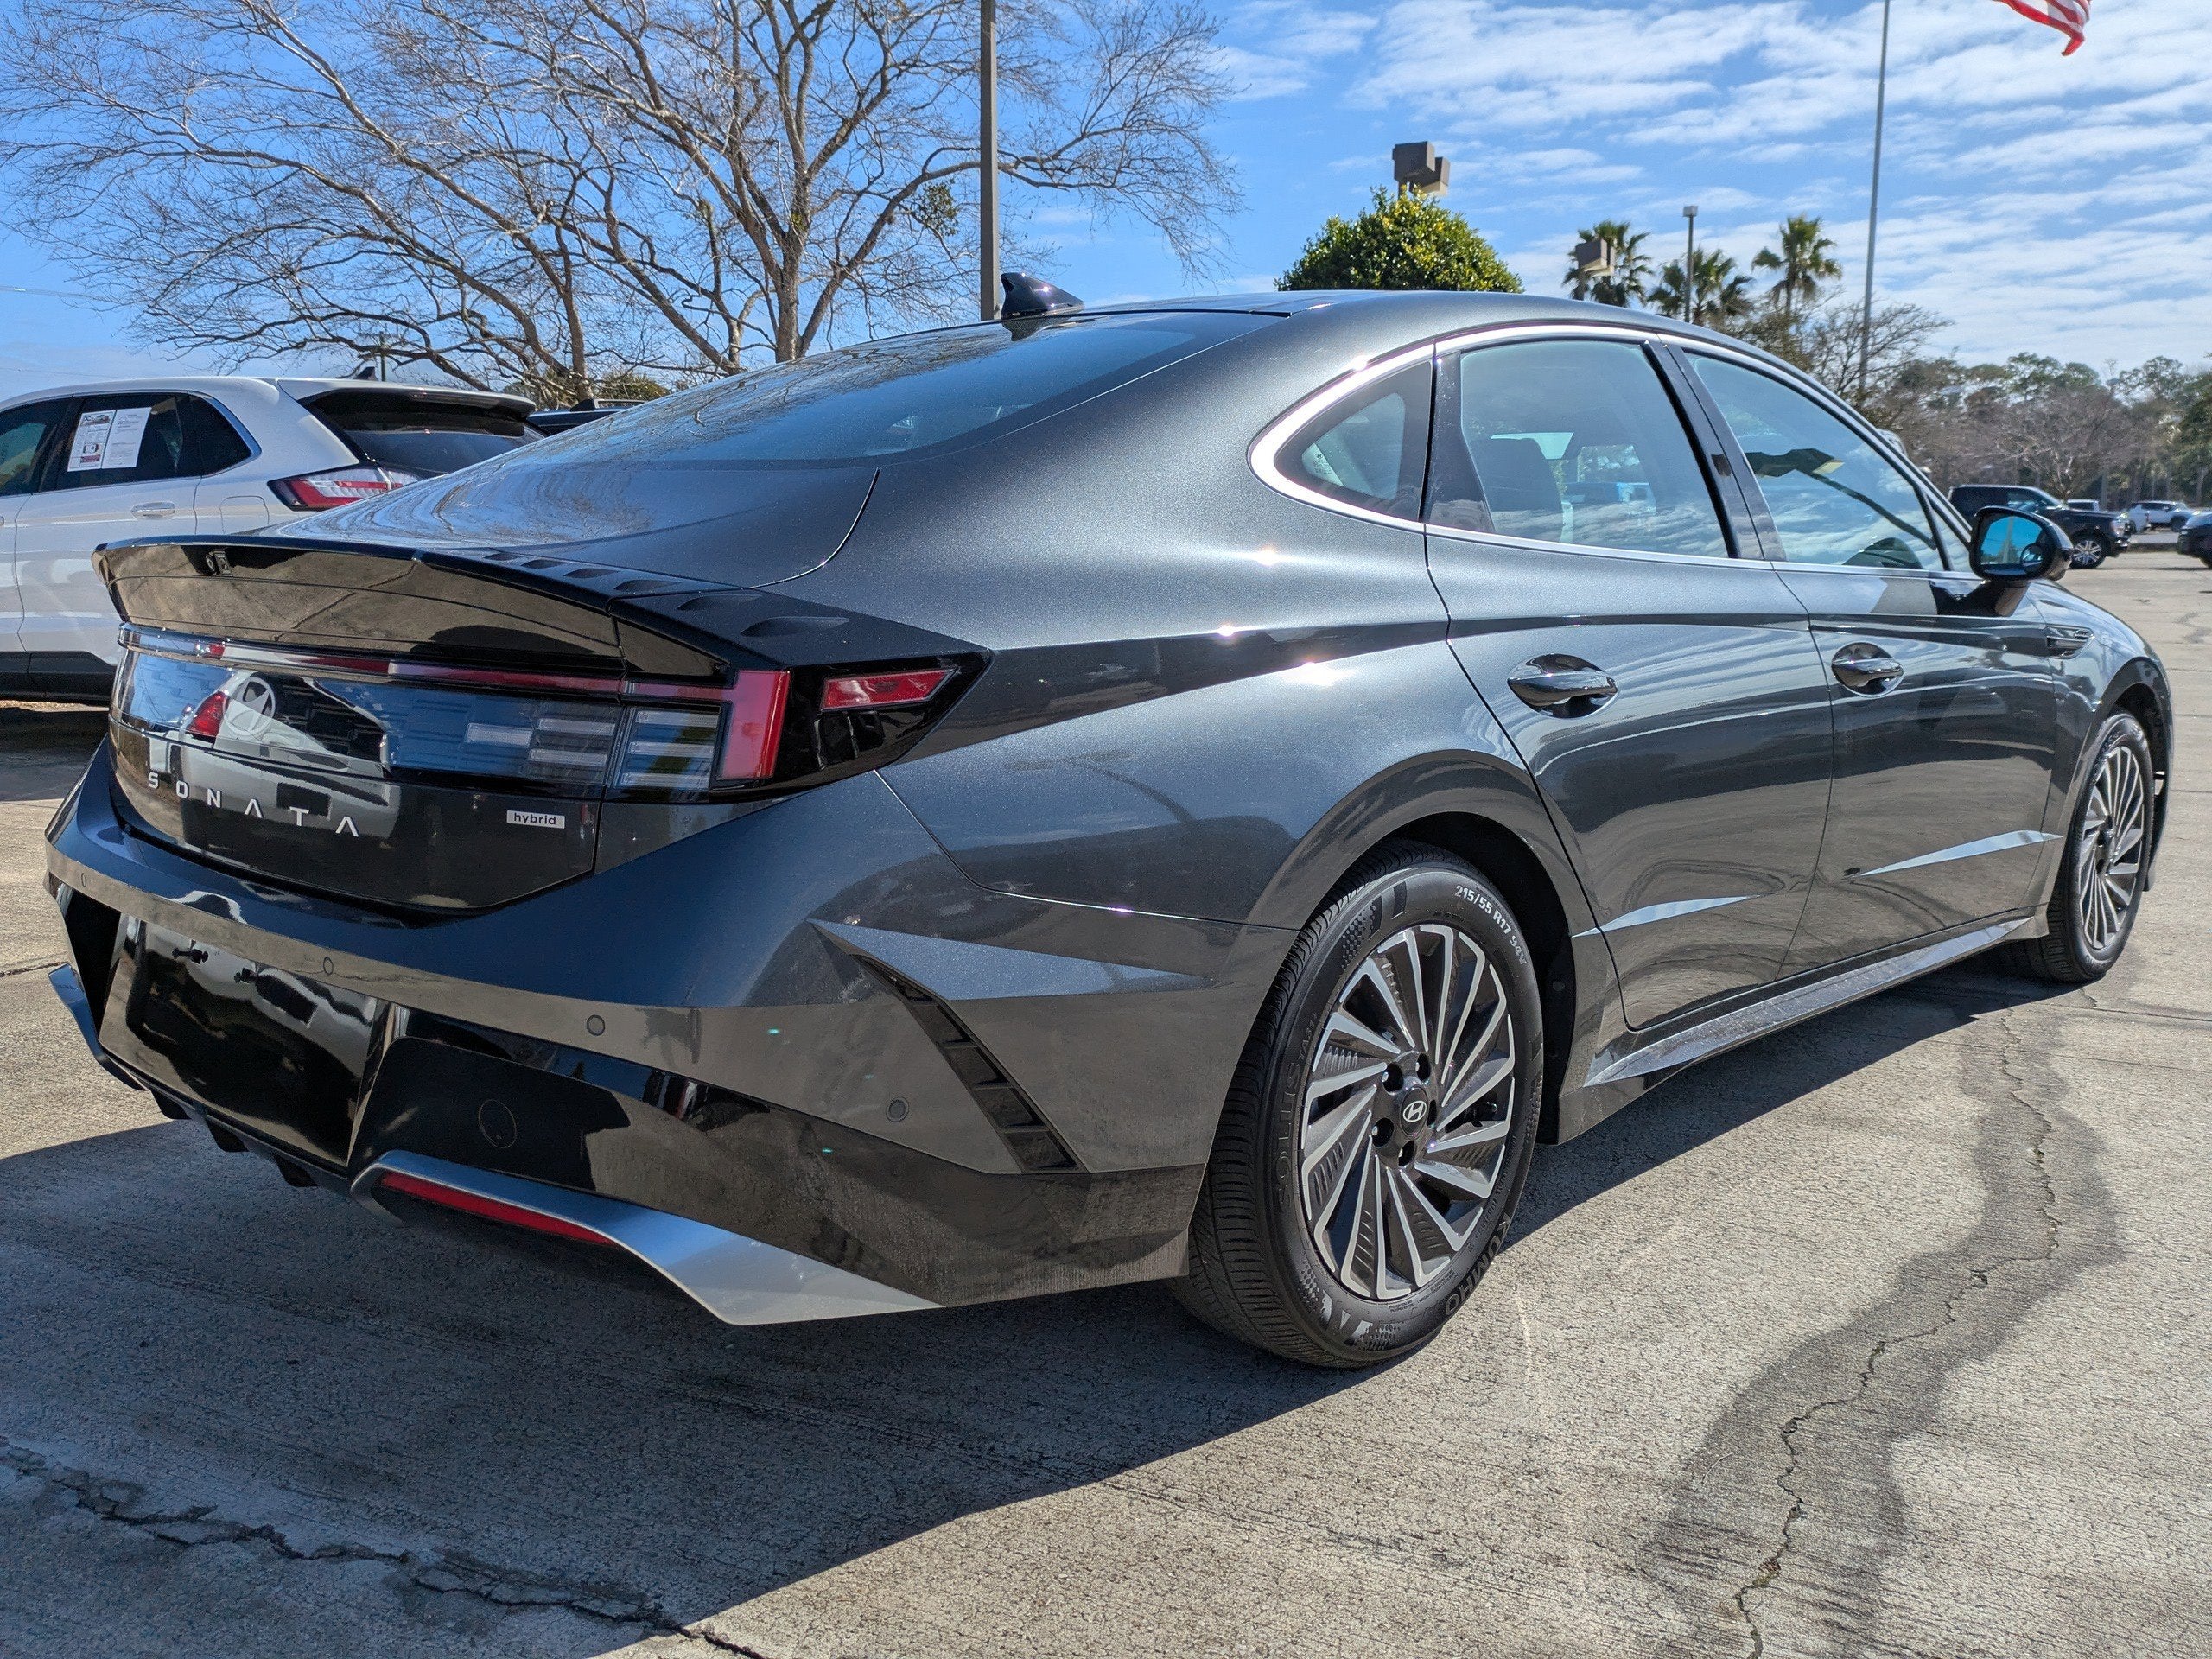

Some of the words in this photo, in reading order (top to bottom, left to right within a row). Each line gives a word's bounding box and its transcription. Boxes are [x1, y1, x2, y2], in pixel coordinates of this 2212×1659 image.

[148, 772, 359, 837] SONATA
[514, 813, 556, 825] hybrid
[1454, 885, 1494, 914] 215/55
[1492, 910, 1512, 934] R17
[1446, 1212, 1510, 1315] KUMHO
